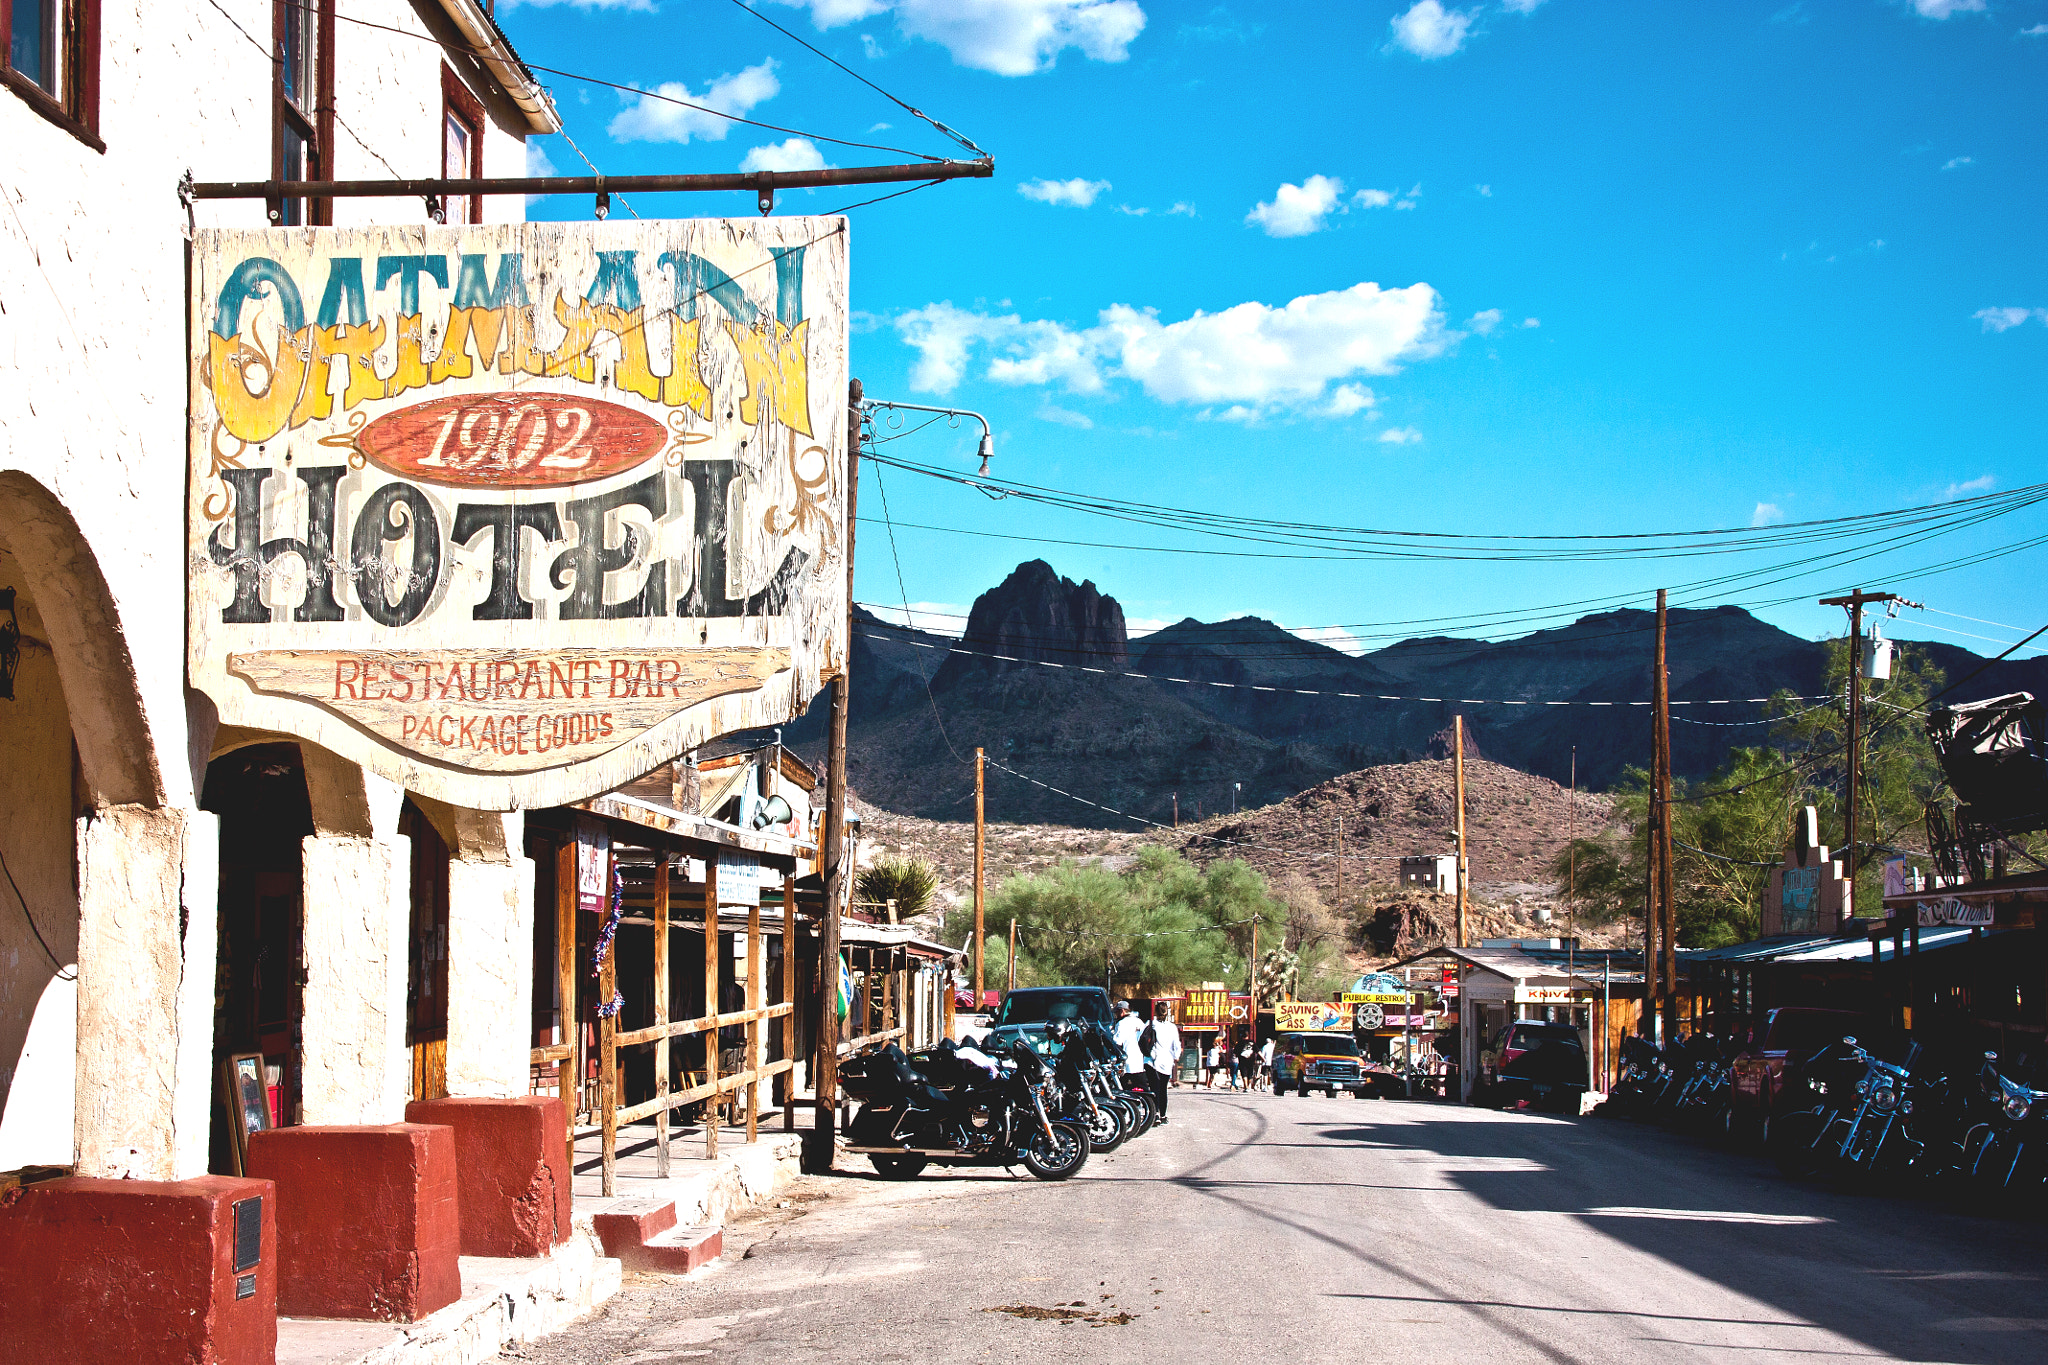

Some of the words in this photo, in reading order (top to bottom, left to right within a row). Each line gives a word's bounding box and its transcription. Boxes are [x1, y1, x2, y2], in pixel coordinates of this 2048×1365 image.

[208, 246, 814, 443] OATMAN
[417, 403, 595, 471] 1902
[207, 459, 813, 628] HOTEL
[608, 659, 682, 698] BAR
[402, 714, 529, 756] PACKAGE
[536, 712, 614, 754] GOODS
[1186, 1005, 1230, 1016] MEMORES
[1190, 992, 1227, 1002] MAKIG
[1280, 1005, 1320, 1015] SAVING
[1286, 1018, 1305, 1029] ASS
